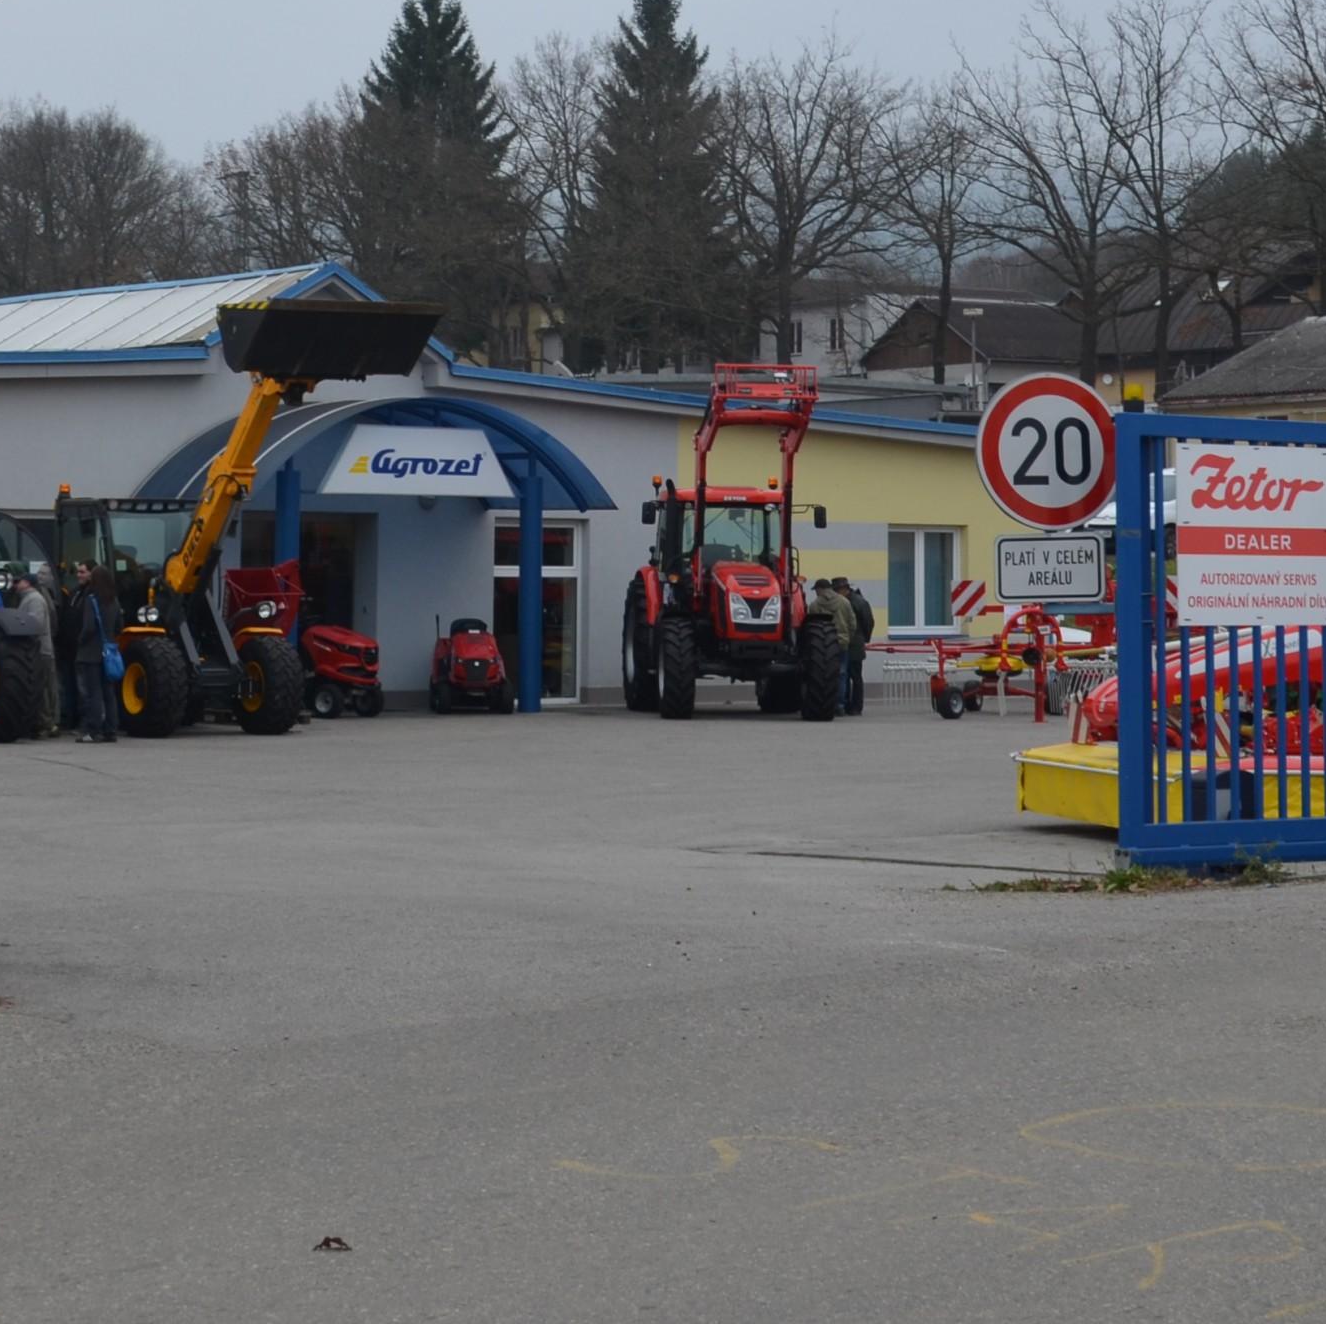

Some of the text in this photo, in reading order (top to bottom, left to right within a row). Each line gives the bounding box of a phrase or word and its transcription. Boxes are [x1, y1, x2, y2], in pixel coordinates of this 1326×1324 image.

[1011, 417, 1092, 486] 20
[370, 448, 484, 479] Agrozet
[1190, 453, 1324, 512] Zetor
[1225, 534, 1292, 551] DEALER
[1004, 546, 1095, 566] PLATÍ V CELÉM
[1027, 567, 1073, 586] AREÁLU
[1200, 570, 1317, 586] AUTORIZOVANÝ SERVIS
[1187, 593, 1250, 608] ORIGINÁLNÍ
[1252, 593, 1308, 609] NÁHRADNÍ
